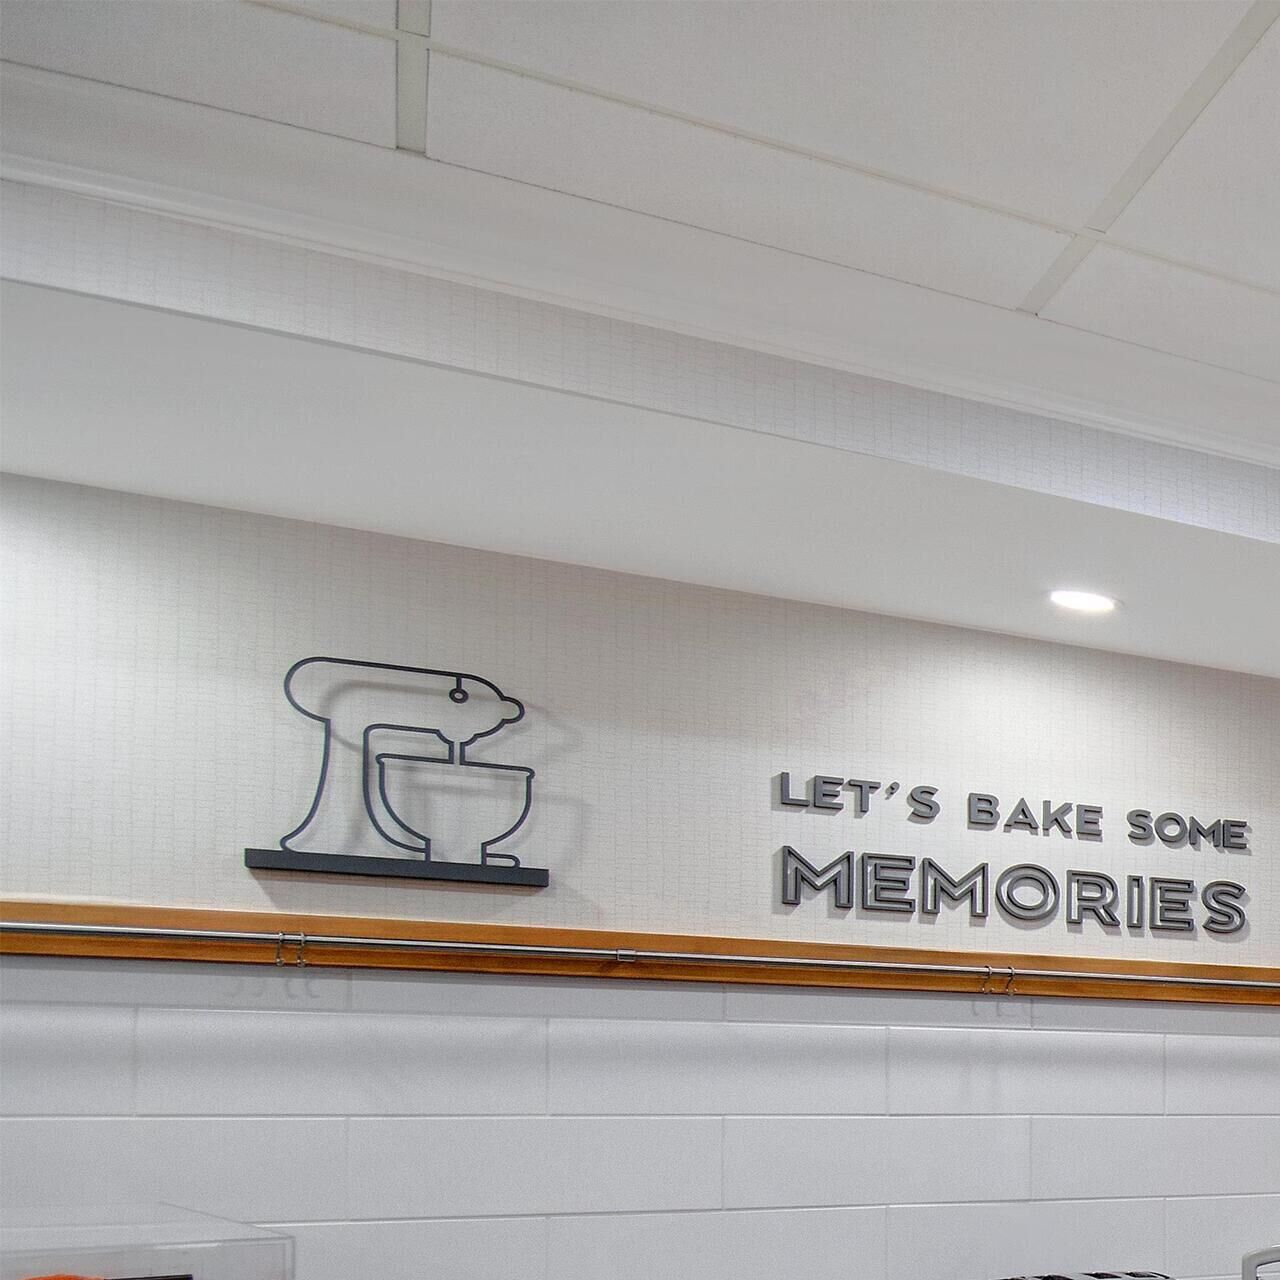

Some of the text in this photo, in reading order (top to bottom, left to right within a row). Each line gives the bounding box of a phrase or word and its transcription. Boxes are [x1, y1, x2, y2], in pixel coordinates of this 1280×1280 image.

[968, 793, 1103, 836] BAKE
[1127, 809, 1247, 849] SOME
[782, 845, 1246, 934] MEMORIES
